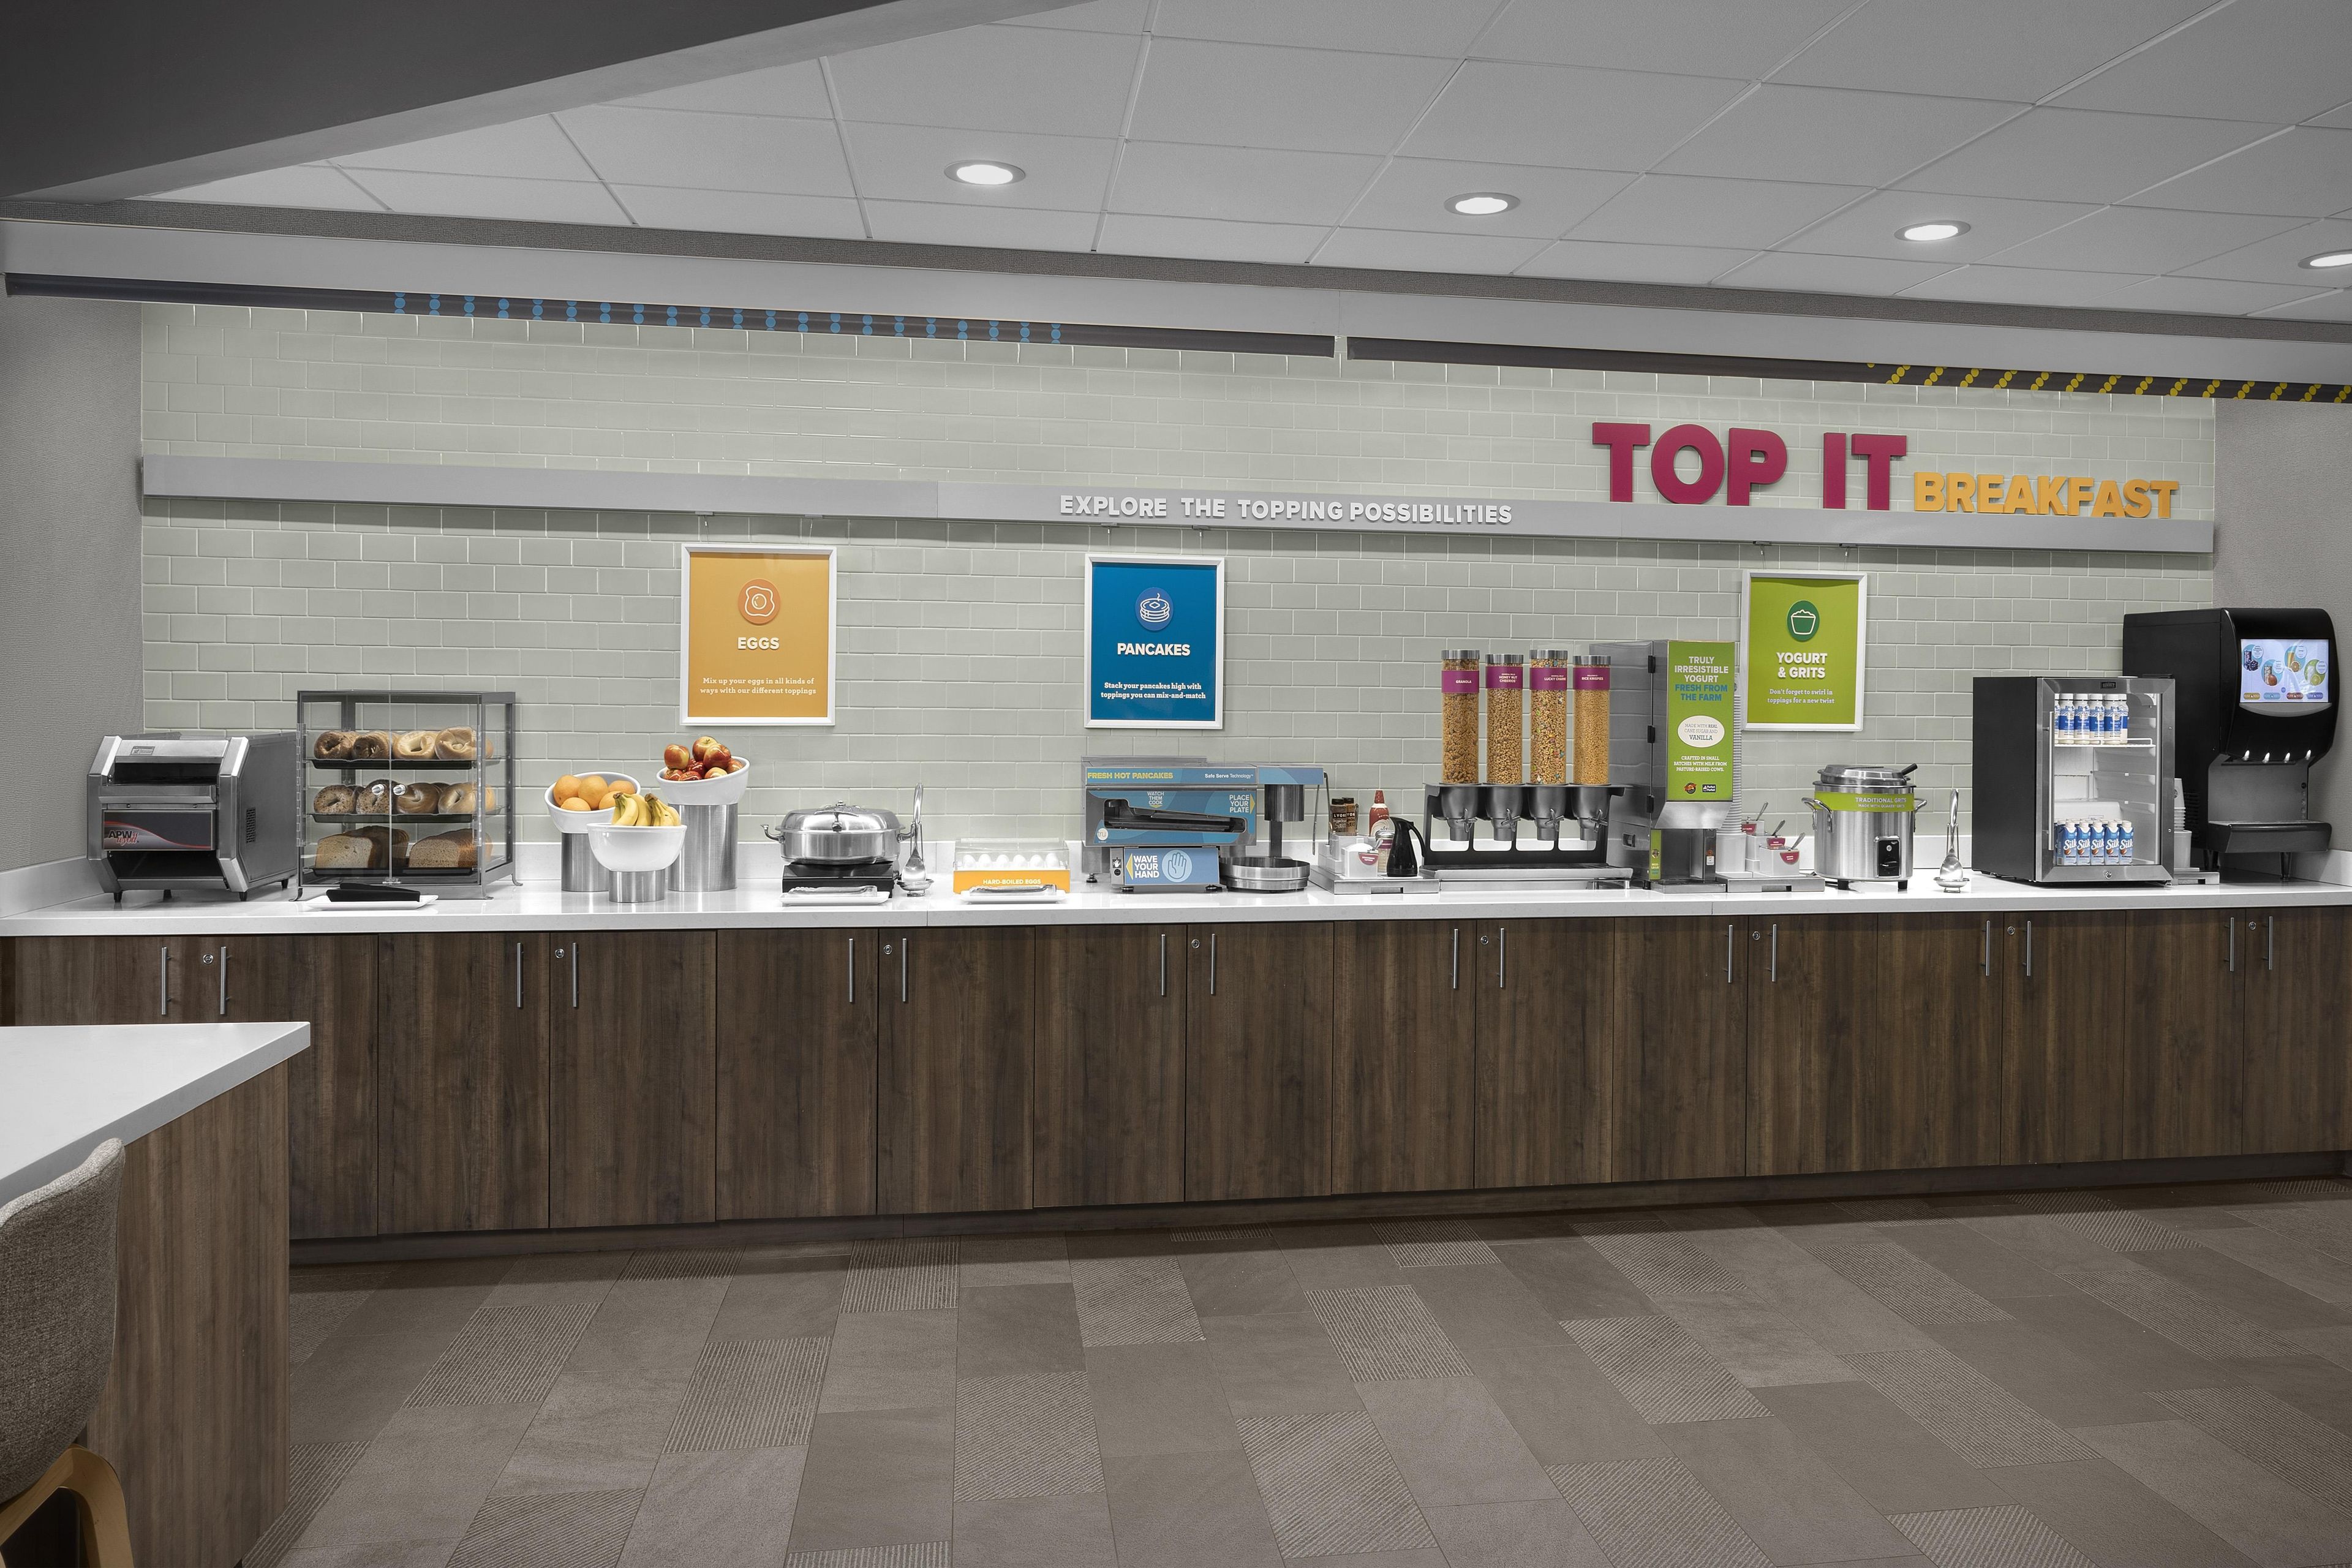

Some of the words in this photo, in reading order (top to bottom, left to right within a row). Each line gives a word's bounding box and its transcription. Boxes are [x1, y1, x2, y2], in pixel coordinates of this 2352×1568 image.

[1593, 422, 1787, 506] TOP
[1823, 432, 1907, 511] IT
[1914, 472, 2179, 518] BREAKFAST
[1060, 495, 1167, 517] EXPLORE
[1181, 497, 1225, 518] THE
[1238, 499, 1343, 520] TOPPING
[1350, 502, 1512, 524] POSSIBILITIES
[737, 637, 780, 650] EGGS
[1117, 643, 1191, 656] PANCAKES
[1776, 652, 1828, 664] YOGURT
[1777, 666, 1786, 678] &
[1789, 666, 1825, 679] GRITS
[2063, 839, 2077, 850] Silk
[2077, 839, 2090, 850] Silk
[2091, 839, 2105, 850] Silk
[2106, 839, 2119, 850] Silk
[2119, 839, 2133, 850] Silk
